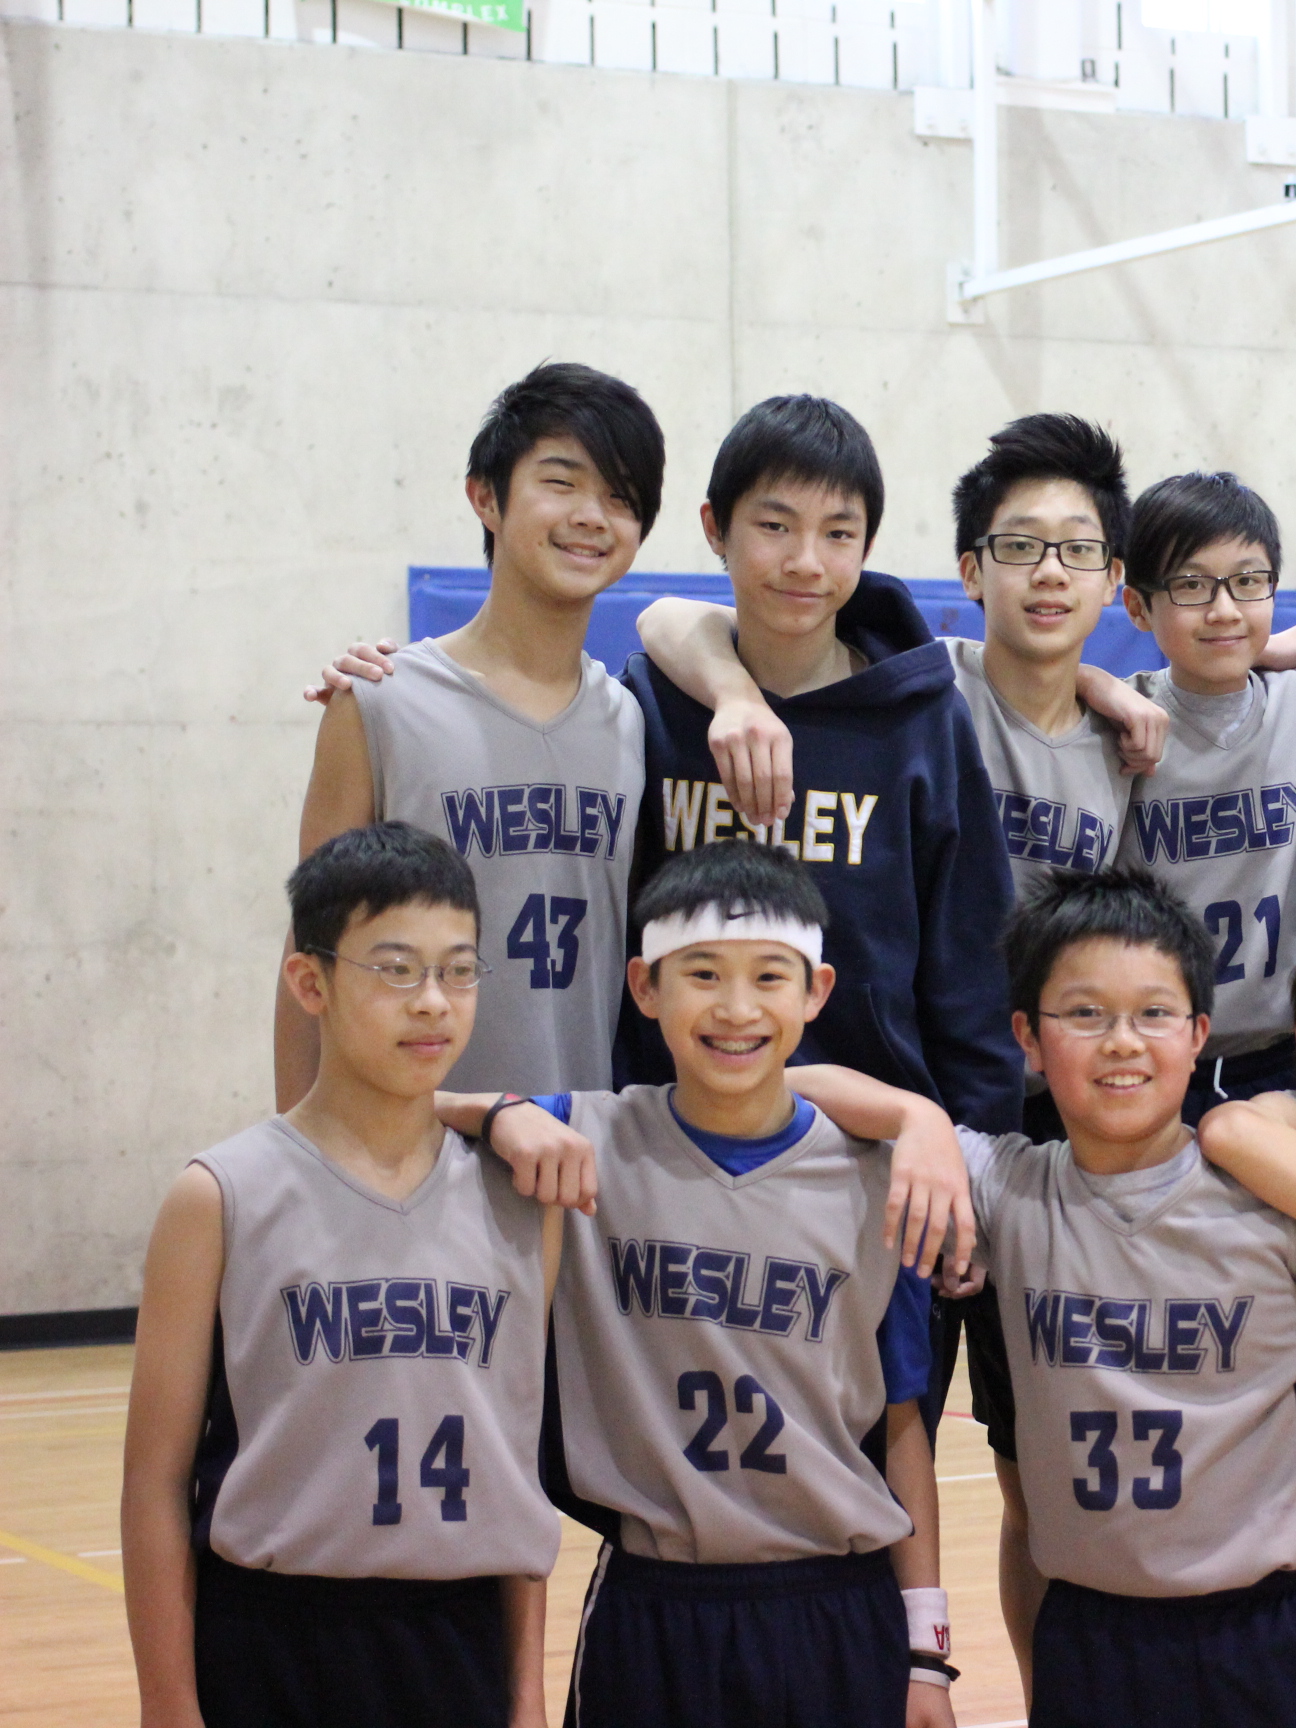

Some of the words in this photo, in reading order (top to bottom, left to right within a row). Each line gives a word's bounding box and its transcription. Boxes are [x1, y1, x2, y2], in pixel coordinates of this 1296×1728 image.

[441, 783, 627, 861] WESLEY
[993, 788, 1114, 875] ESLEY
[507, 893, 588, 989] 43
[1204, 894, 1281, 985] 21
[281, 1278, 511, 1368] WESLEY
[608, 1237, 850, 1342] WESLEY
[1024, 1288, 1254, 1374] WESLEY
[678, 1370, 787, 1474] 22
[1070, 1410, 1183, 1510] 33
[364, 1415, 470, 1526] 14
